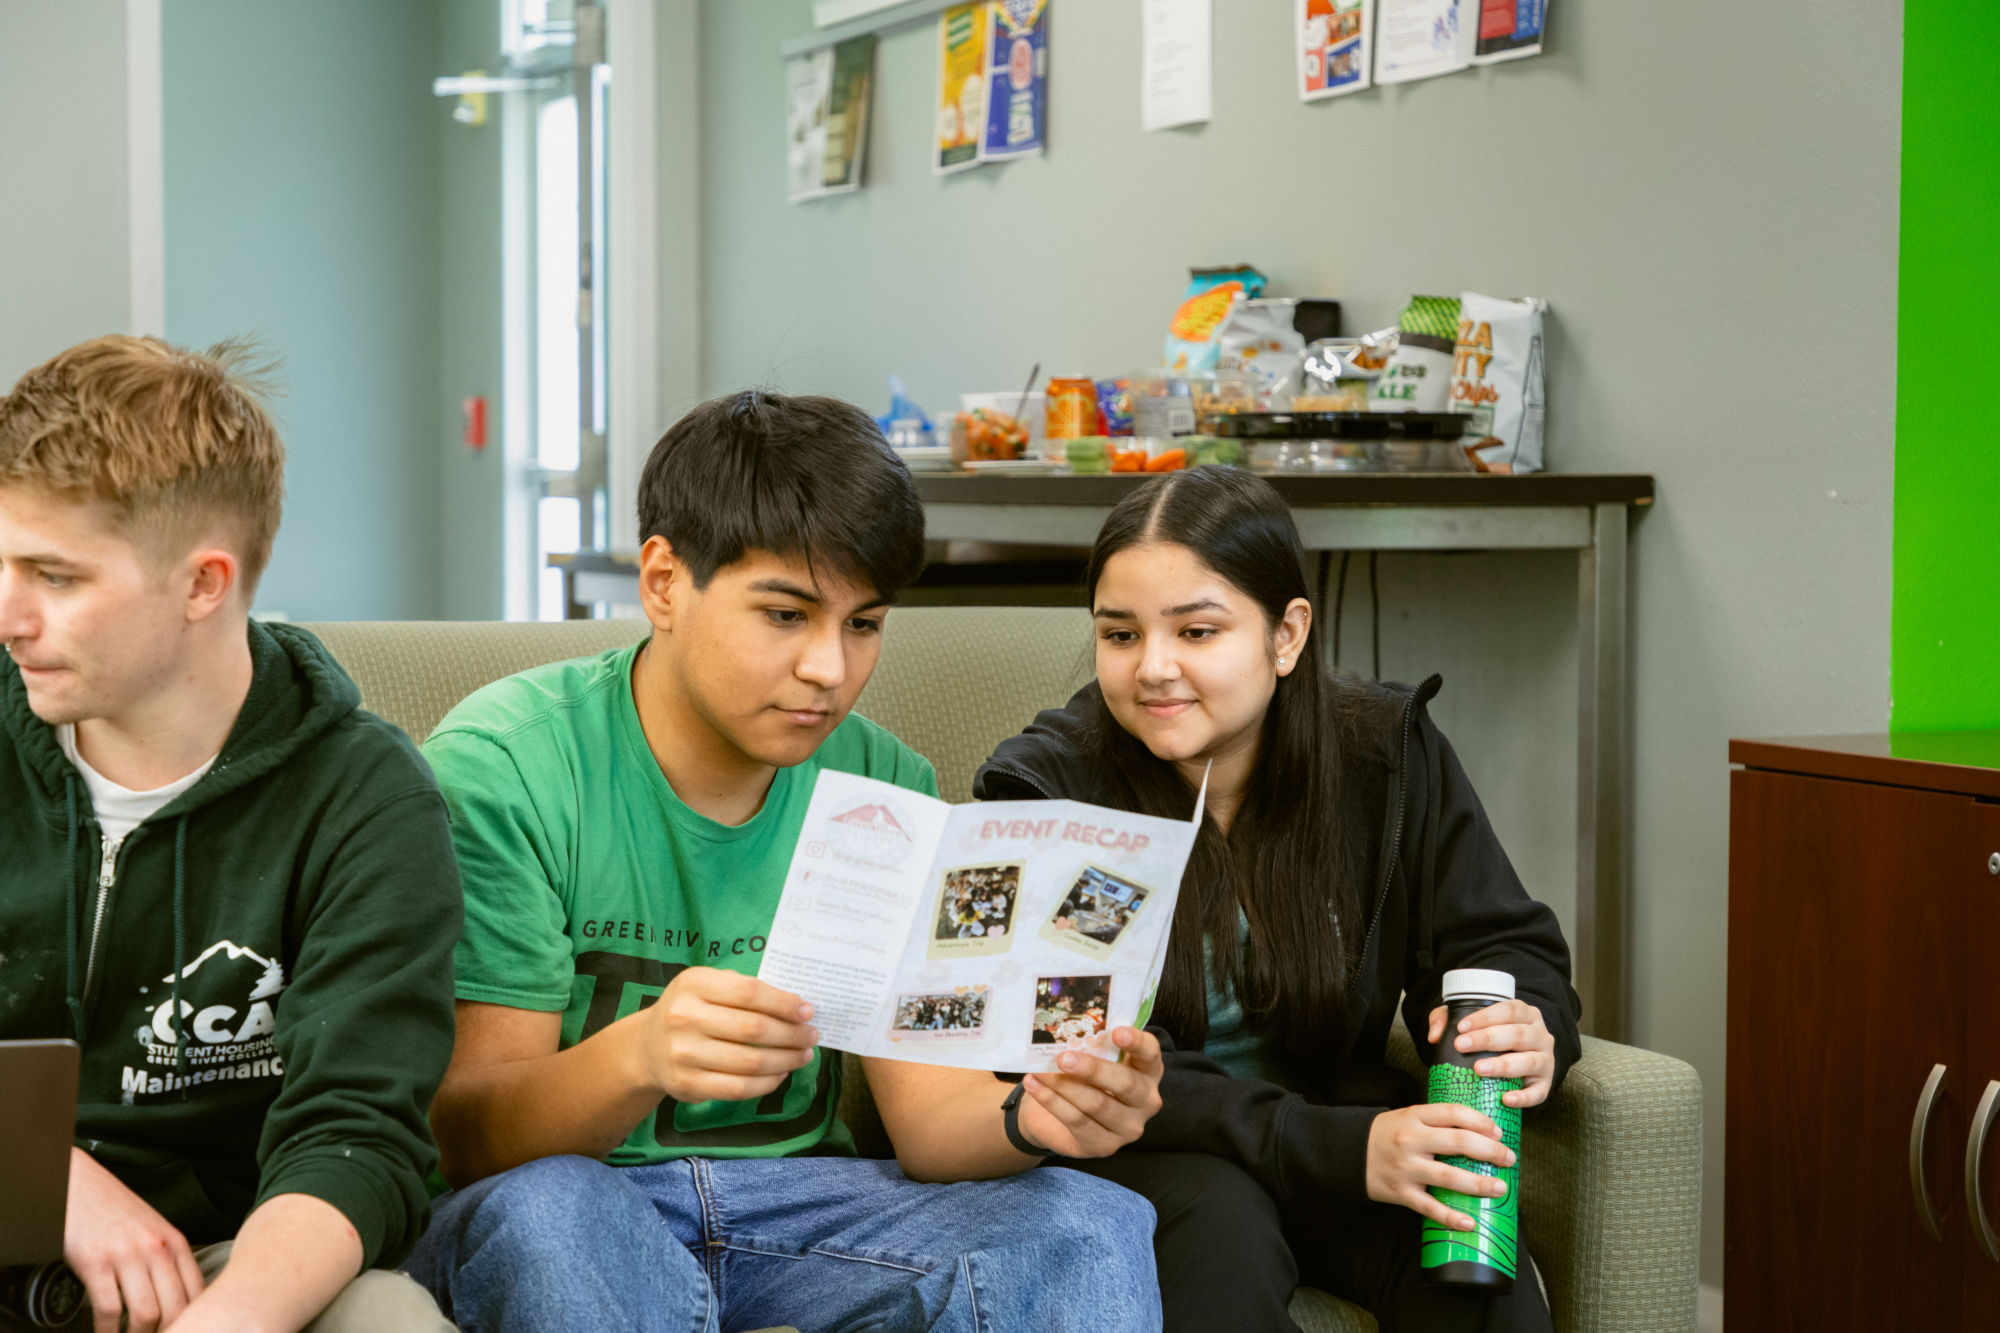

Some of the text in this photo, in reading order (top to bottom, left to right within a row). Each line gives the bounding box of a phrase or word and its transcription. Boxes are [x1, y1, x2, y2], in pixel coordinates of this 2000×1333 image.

[979, 819, 1151, 851] EVENT RECAP
[664, 929, 720, 957] RIVR
[731, 935, 767, 955] CO
[152, 997, 277, 1044] CCA
[146, 1047, 276, 1066] GREE RIVER COLLEG
[122, 1056, 285, 1094] Maintenanc
